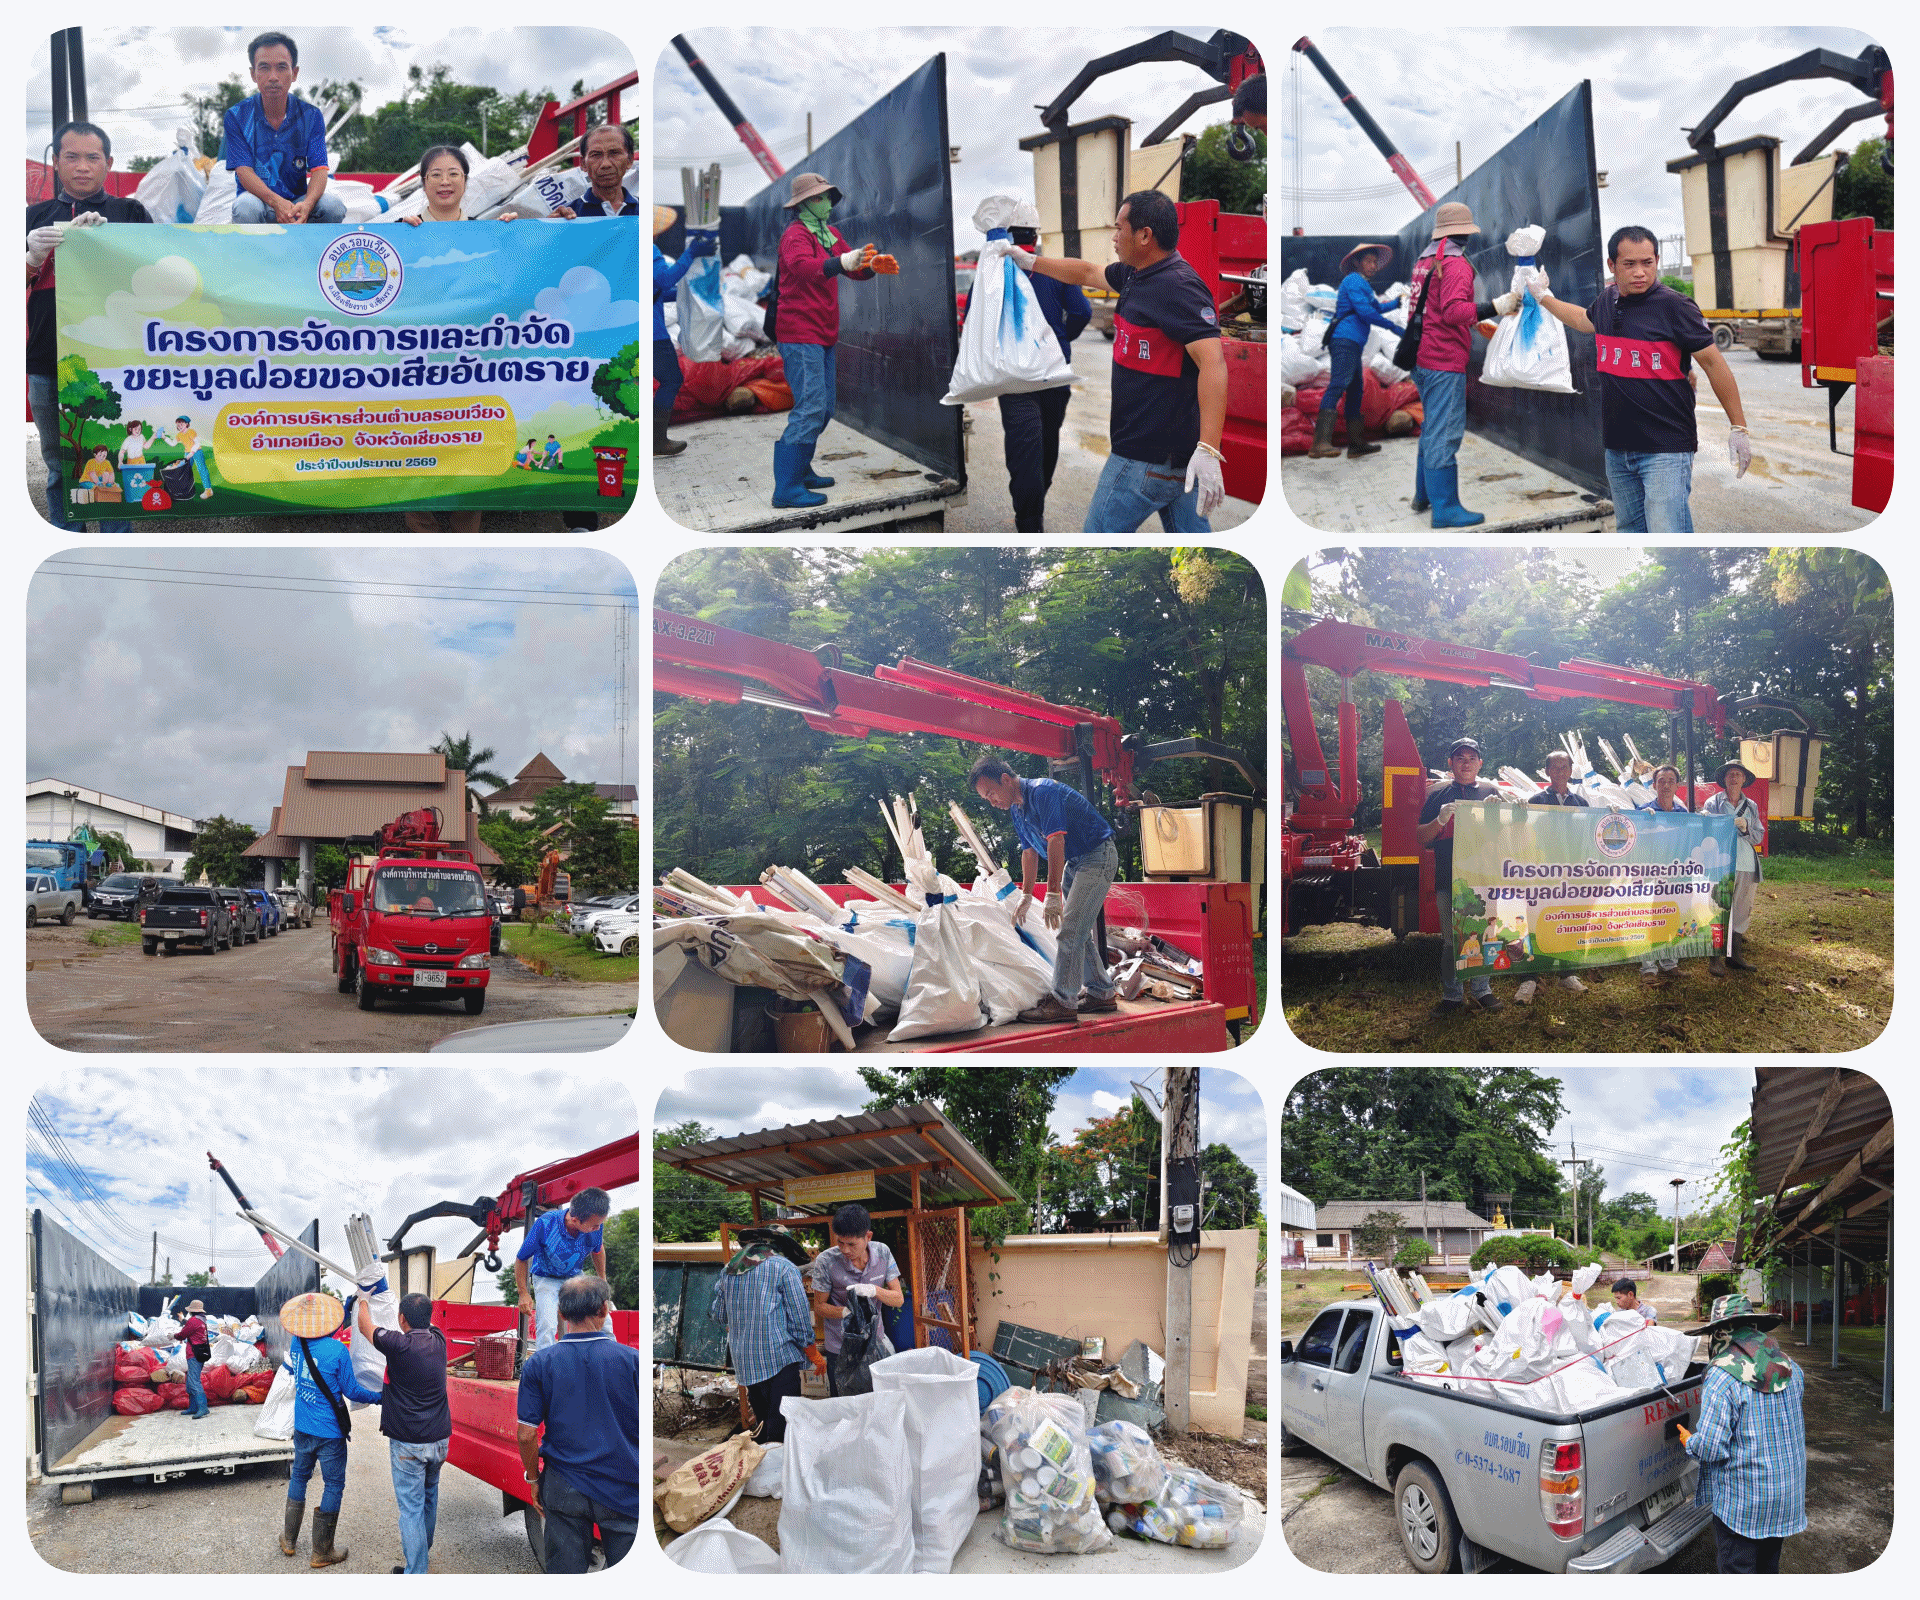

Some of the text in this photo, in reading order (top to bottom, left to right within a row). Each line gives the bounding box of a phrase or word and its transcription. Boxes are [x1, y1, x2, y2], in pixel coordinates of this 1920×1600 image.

[329, 238, 391, 262] อบต.รอบเวียง
[147, 315, 570, 352] โครงการจัดการและกำจัด
[123, 355, 590, 401] ขยะมูลฝอยของเสียอันตราย
[228, 404, 506, 427] องค์การบริหารส่วนตำบลรอบเวียง
[252, 430, 482, 449] อำเภอเมือง จังหวัดเชียงราย
[296, 457, 437, 471] ประจำปีงบประมาณ 2569
[382, 867, 475, 882] องค์การบริหารส่วนตำบลรอบเวียง
[1503, 860, 1704, 878] โครงการจัดการและกำจัด
[1488, 880, 1711, 906] ขยะมูลฝอยของเสียอันตราย
[1545, 906, 1676, 921] องค์การบริหารส่วนตำบลรอบเวียง
[1643, 1387, 1702, 1426] RESCUE
[1484, 1430, 1531, 1460] อบต.รอบเวียง
[1465, 1451, 1521, 1486] 0-5374-2687
